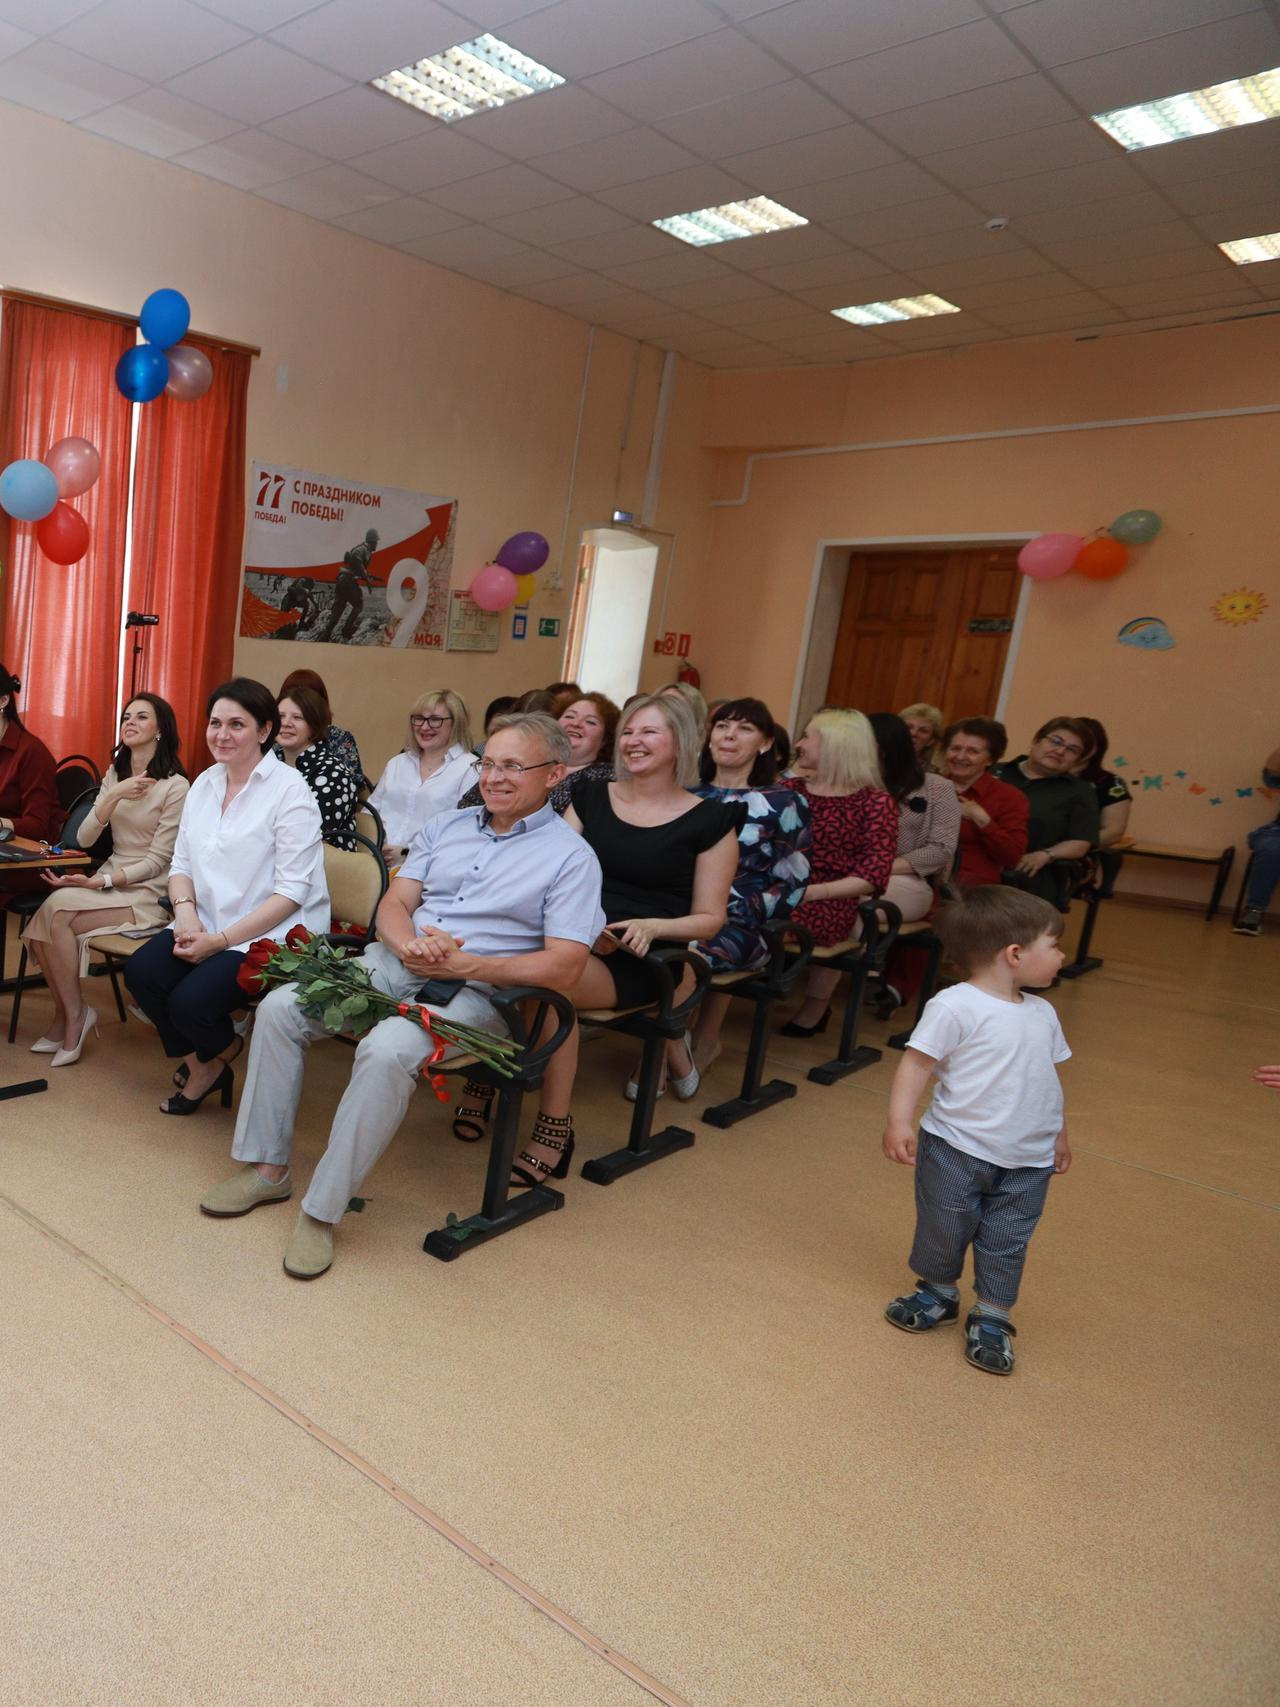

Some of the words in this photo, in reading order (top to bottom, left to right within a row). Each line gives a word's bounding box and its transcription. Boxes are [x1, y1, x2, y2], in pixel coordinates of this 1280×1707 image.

[256, 471, 286, 509] 77
[293, 480, 302, 494] С
[303, 481, 382, 508] ПРАЗДНИКОМ
[254, 510, 287, 525] ПОБЕДА!
[291, 500, 345, 521] ПОБЕДЫ!
[386, 557, 430, 648] 9
